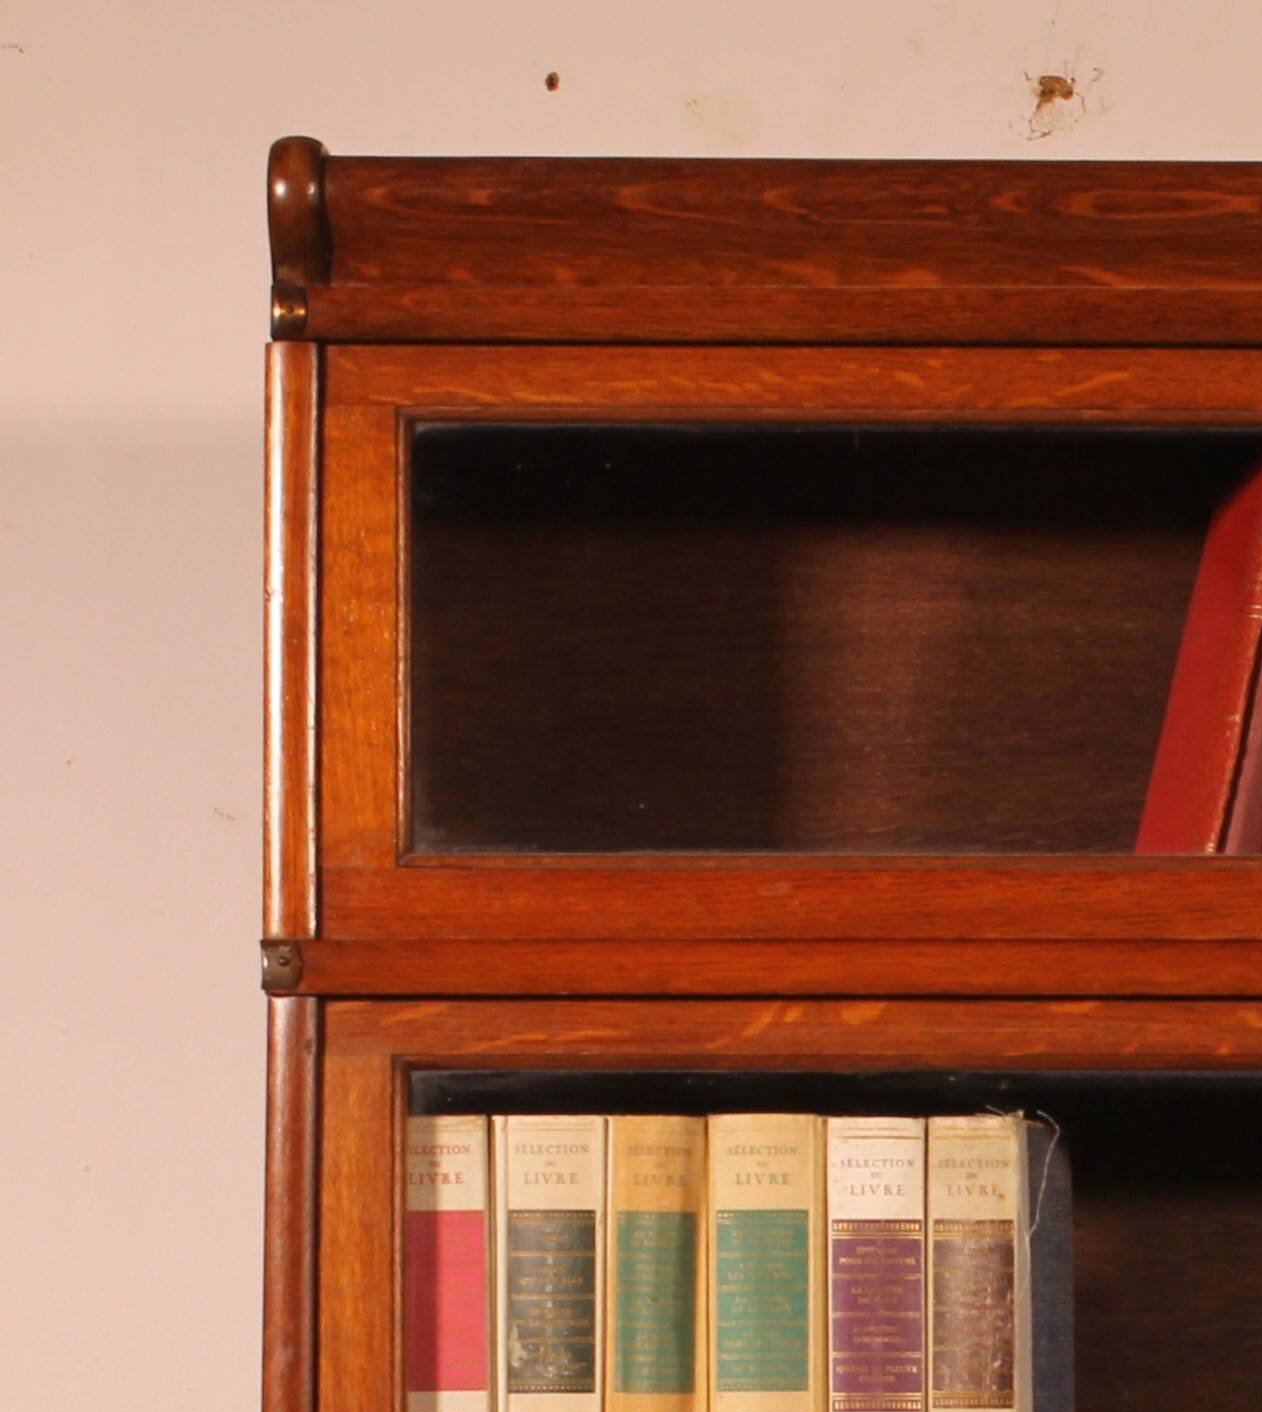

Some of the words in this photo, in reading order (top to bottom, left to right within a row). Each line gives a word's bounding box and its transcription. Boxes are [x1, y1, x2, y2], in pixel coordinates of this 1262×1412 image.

[408, 1172, 464, 1185] LIVRE
[523, 1172, 579, 1185] LIVRE
[735, 1172, 791, 1185] LIVRE
[850, 1184, 905, 1196] LIVRE
[947, 1185, 1000, 1196] LIVRE
